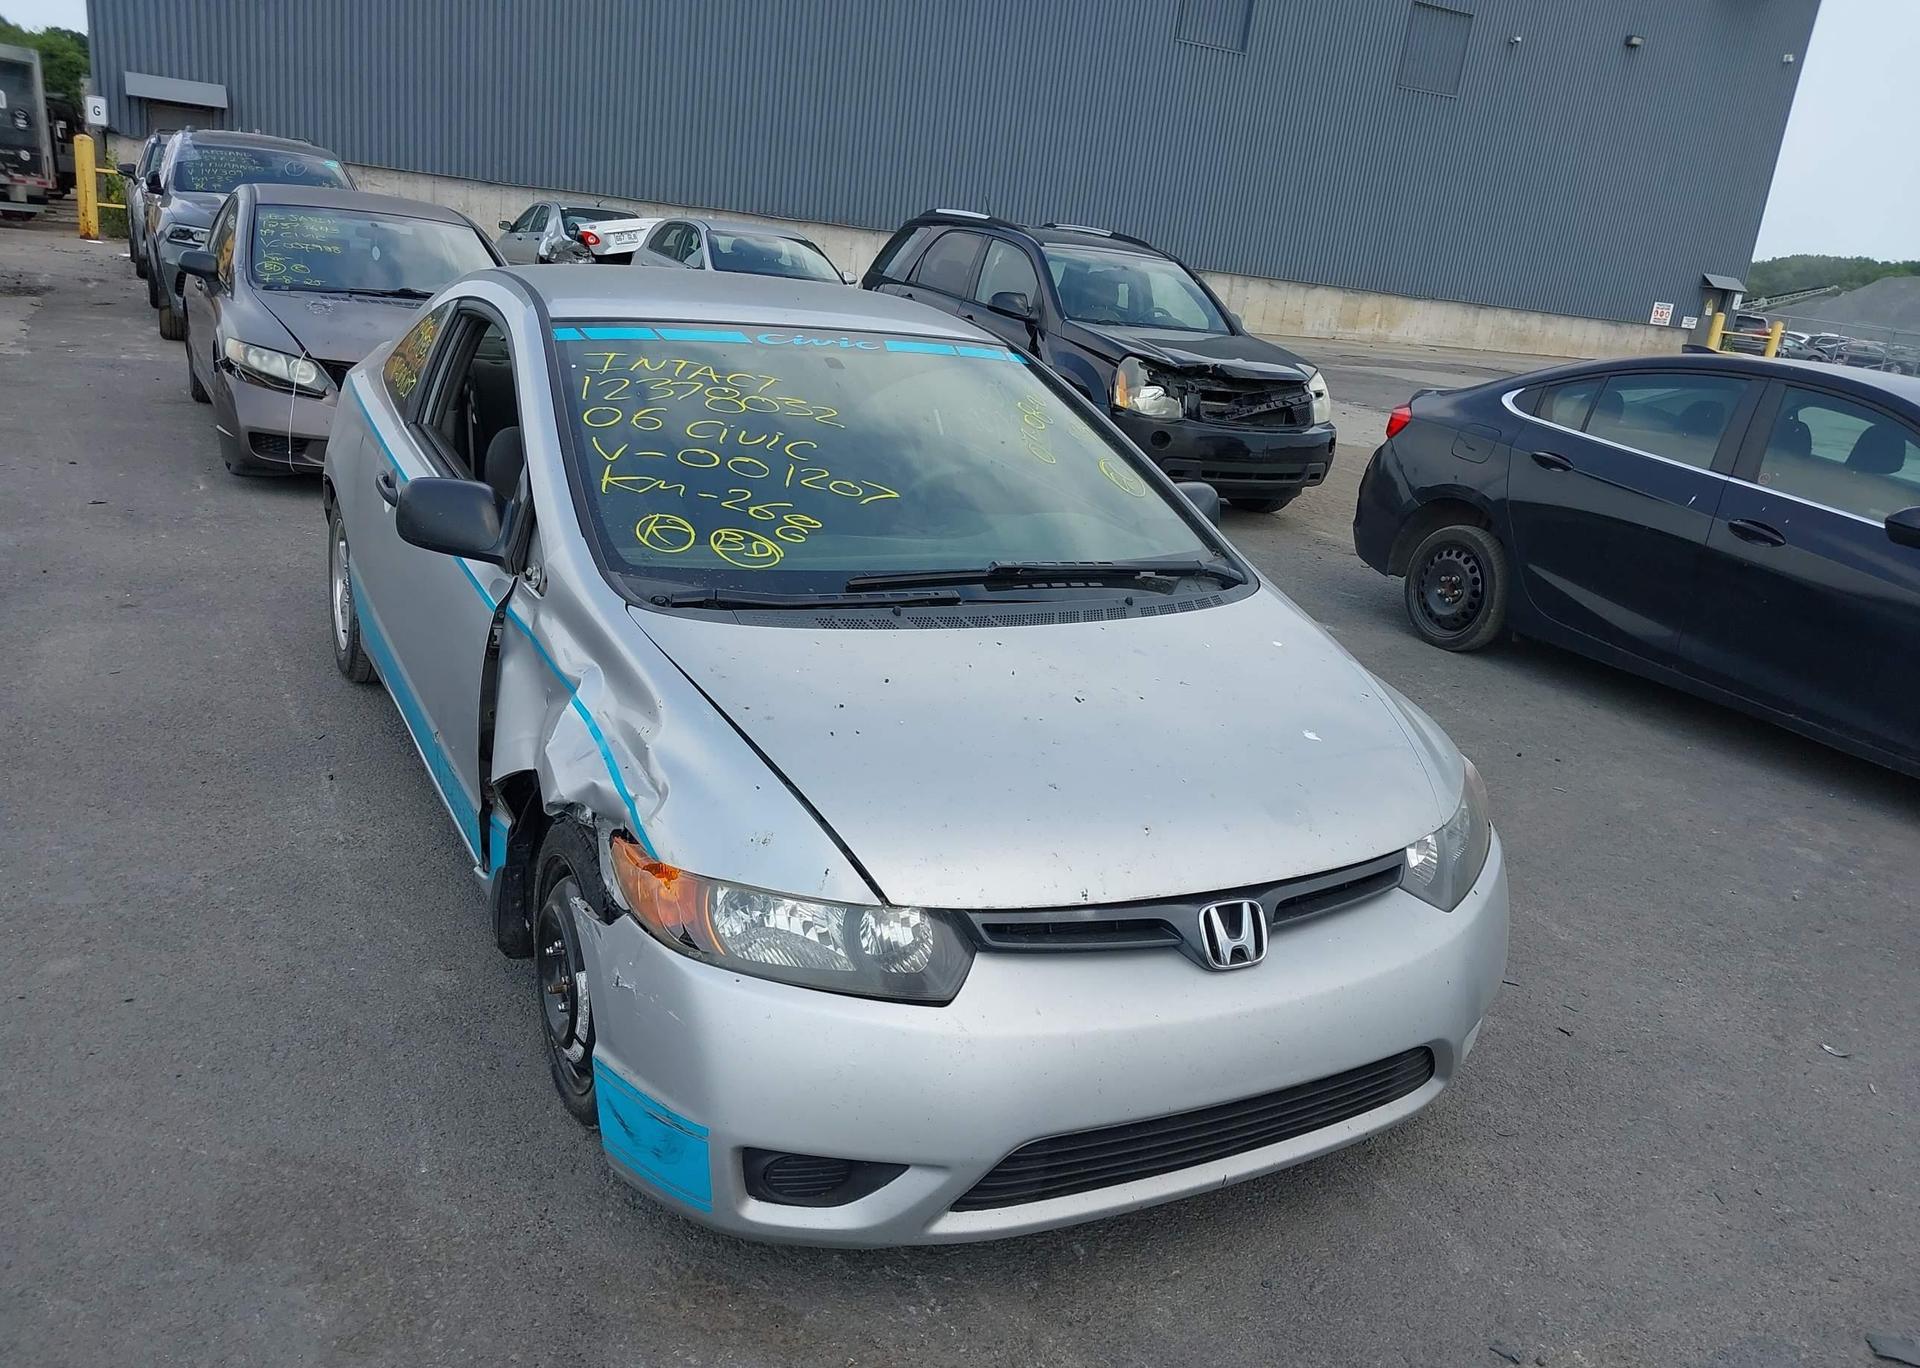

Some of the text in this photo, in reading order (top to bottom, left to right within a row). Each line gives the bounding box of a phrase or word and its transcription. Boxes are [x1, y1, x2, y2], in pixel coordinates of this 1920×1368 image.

[93, 106, 101, 116] G
[756, 332, 881, 351] Civic
[583, 351, 783, 393] INTACT
[581, 375, 846, 429] 12378032
[582, 406, 668, 431] 06
